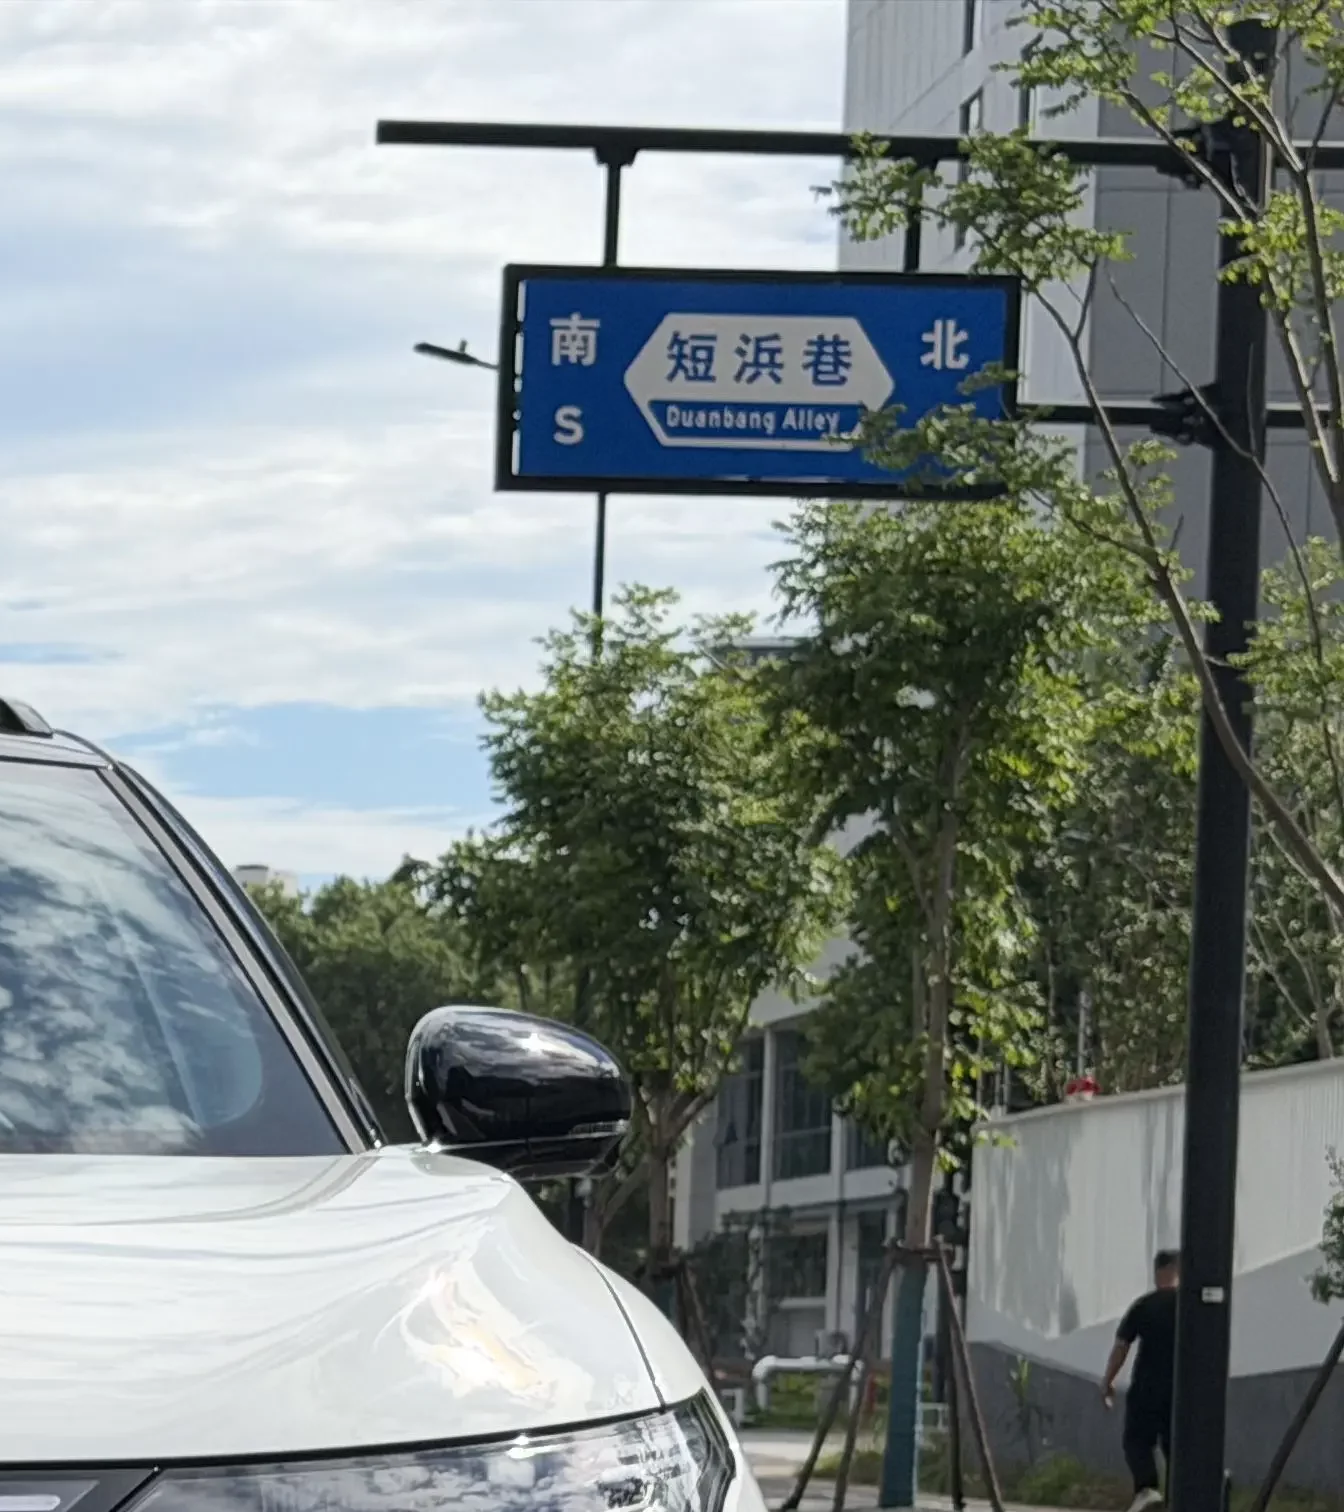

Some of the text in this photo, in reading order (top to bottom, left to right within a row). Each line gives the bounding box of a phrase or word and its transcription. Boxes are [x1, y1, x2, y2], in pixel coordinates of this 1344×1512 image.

[549, 312, 601, 367] 南
[666, 331, 852, 387] 短浜巷
[919, 319, 971, 371] 北
[553, 405, 584, 446] S
[665, 404, 841, 436] Duanbang Alley
